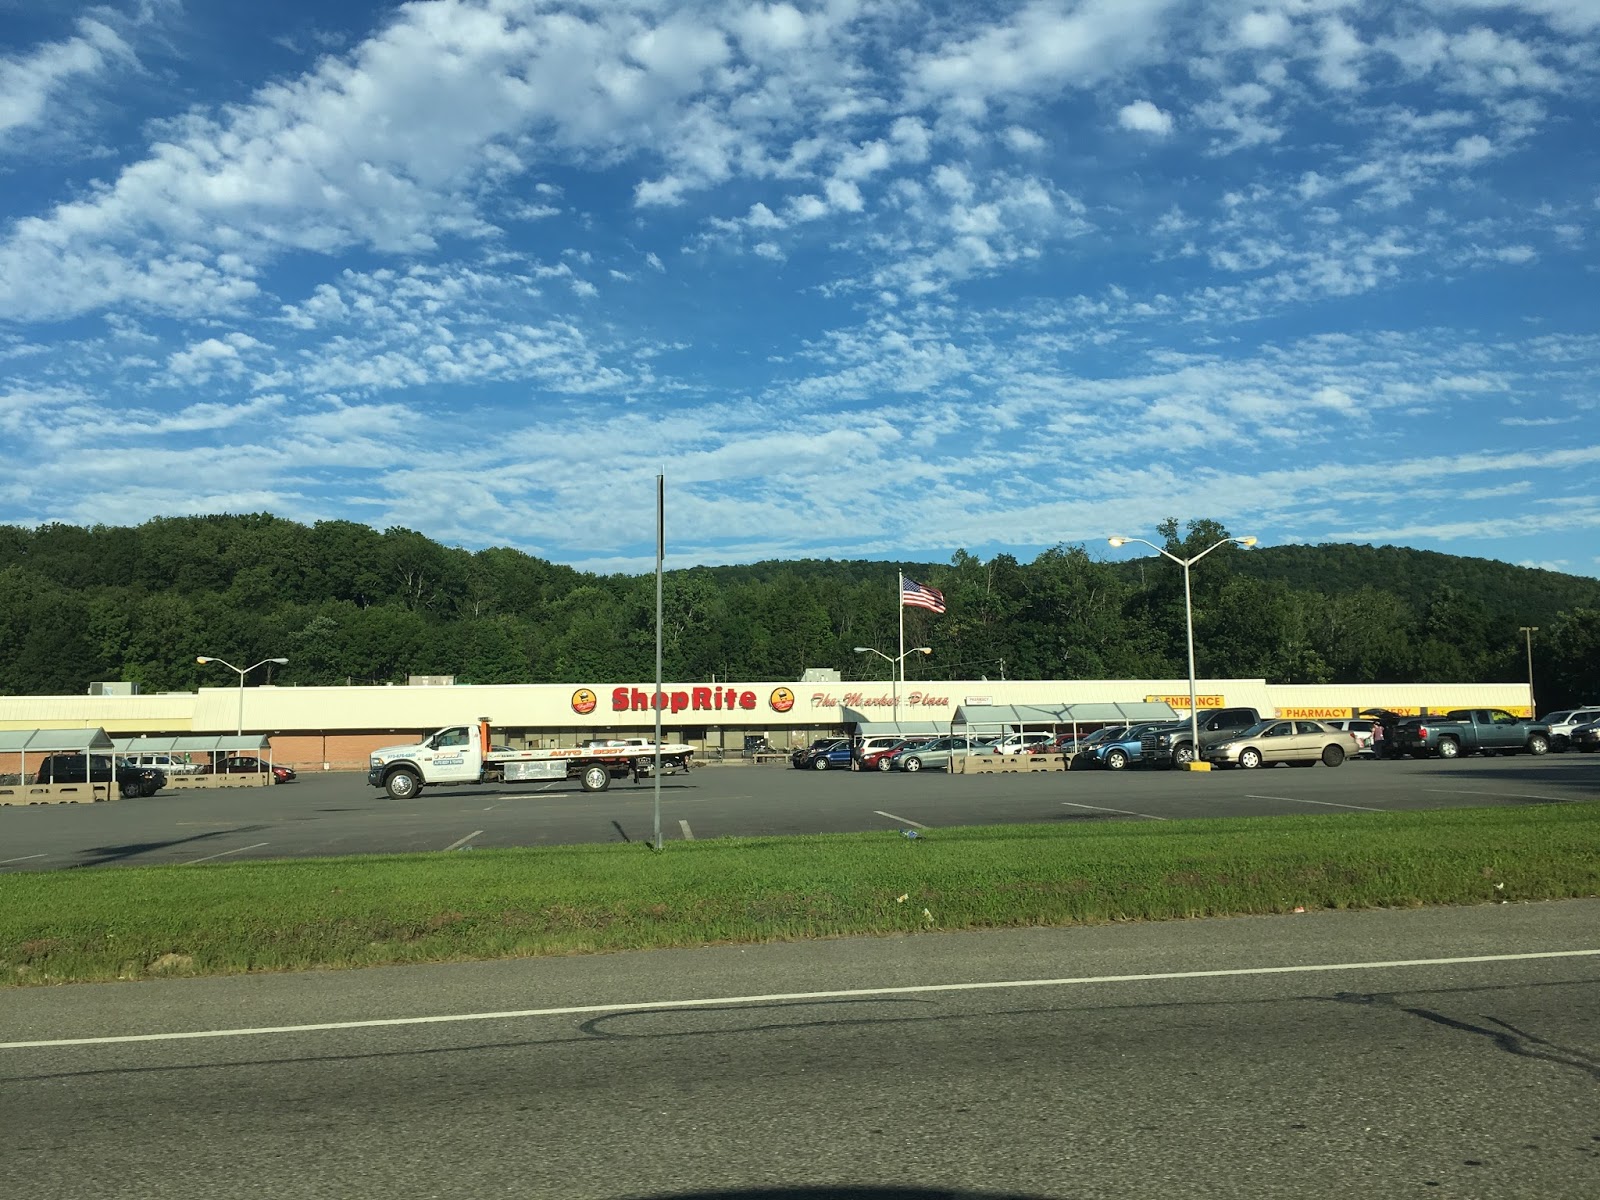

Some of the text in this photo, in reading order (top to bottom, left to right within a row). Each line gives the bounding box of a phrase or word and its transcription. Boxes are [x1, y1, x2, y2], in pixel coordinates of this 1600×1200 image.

[612, 687, 757, 714] ShopRite
[812, 691, 949, 707] The Market Place
[1165, 697, 1220, 706] ENTRNCE
[1286, 709, 1348, 718] PHARMACY
